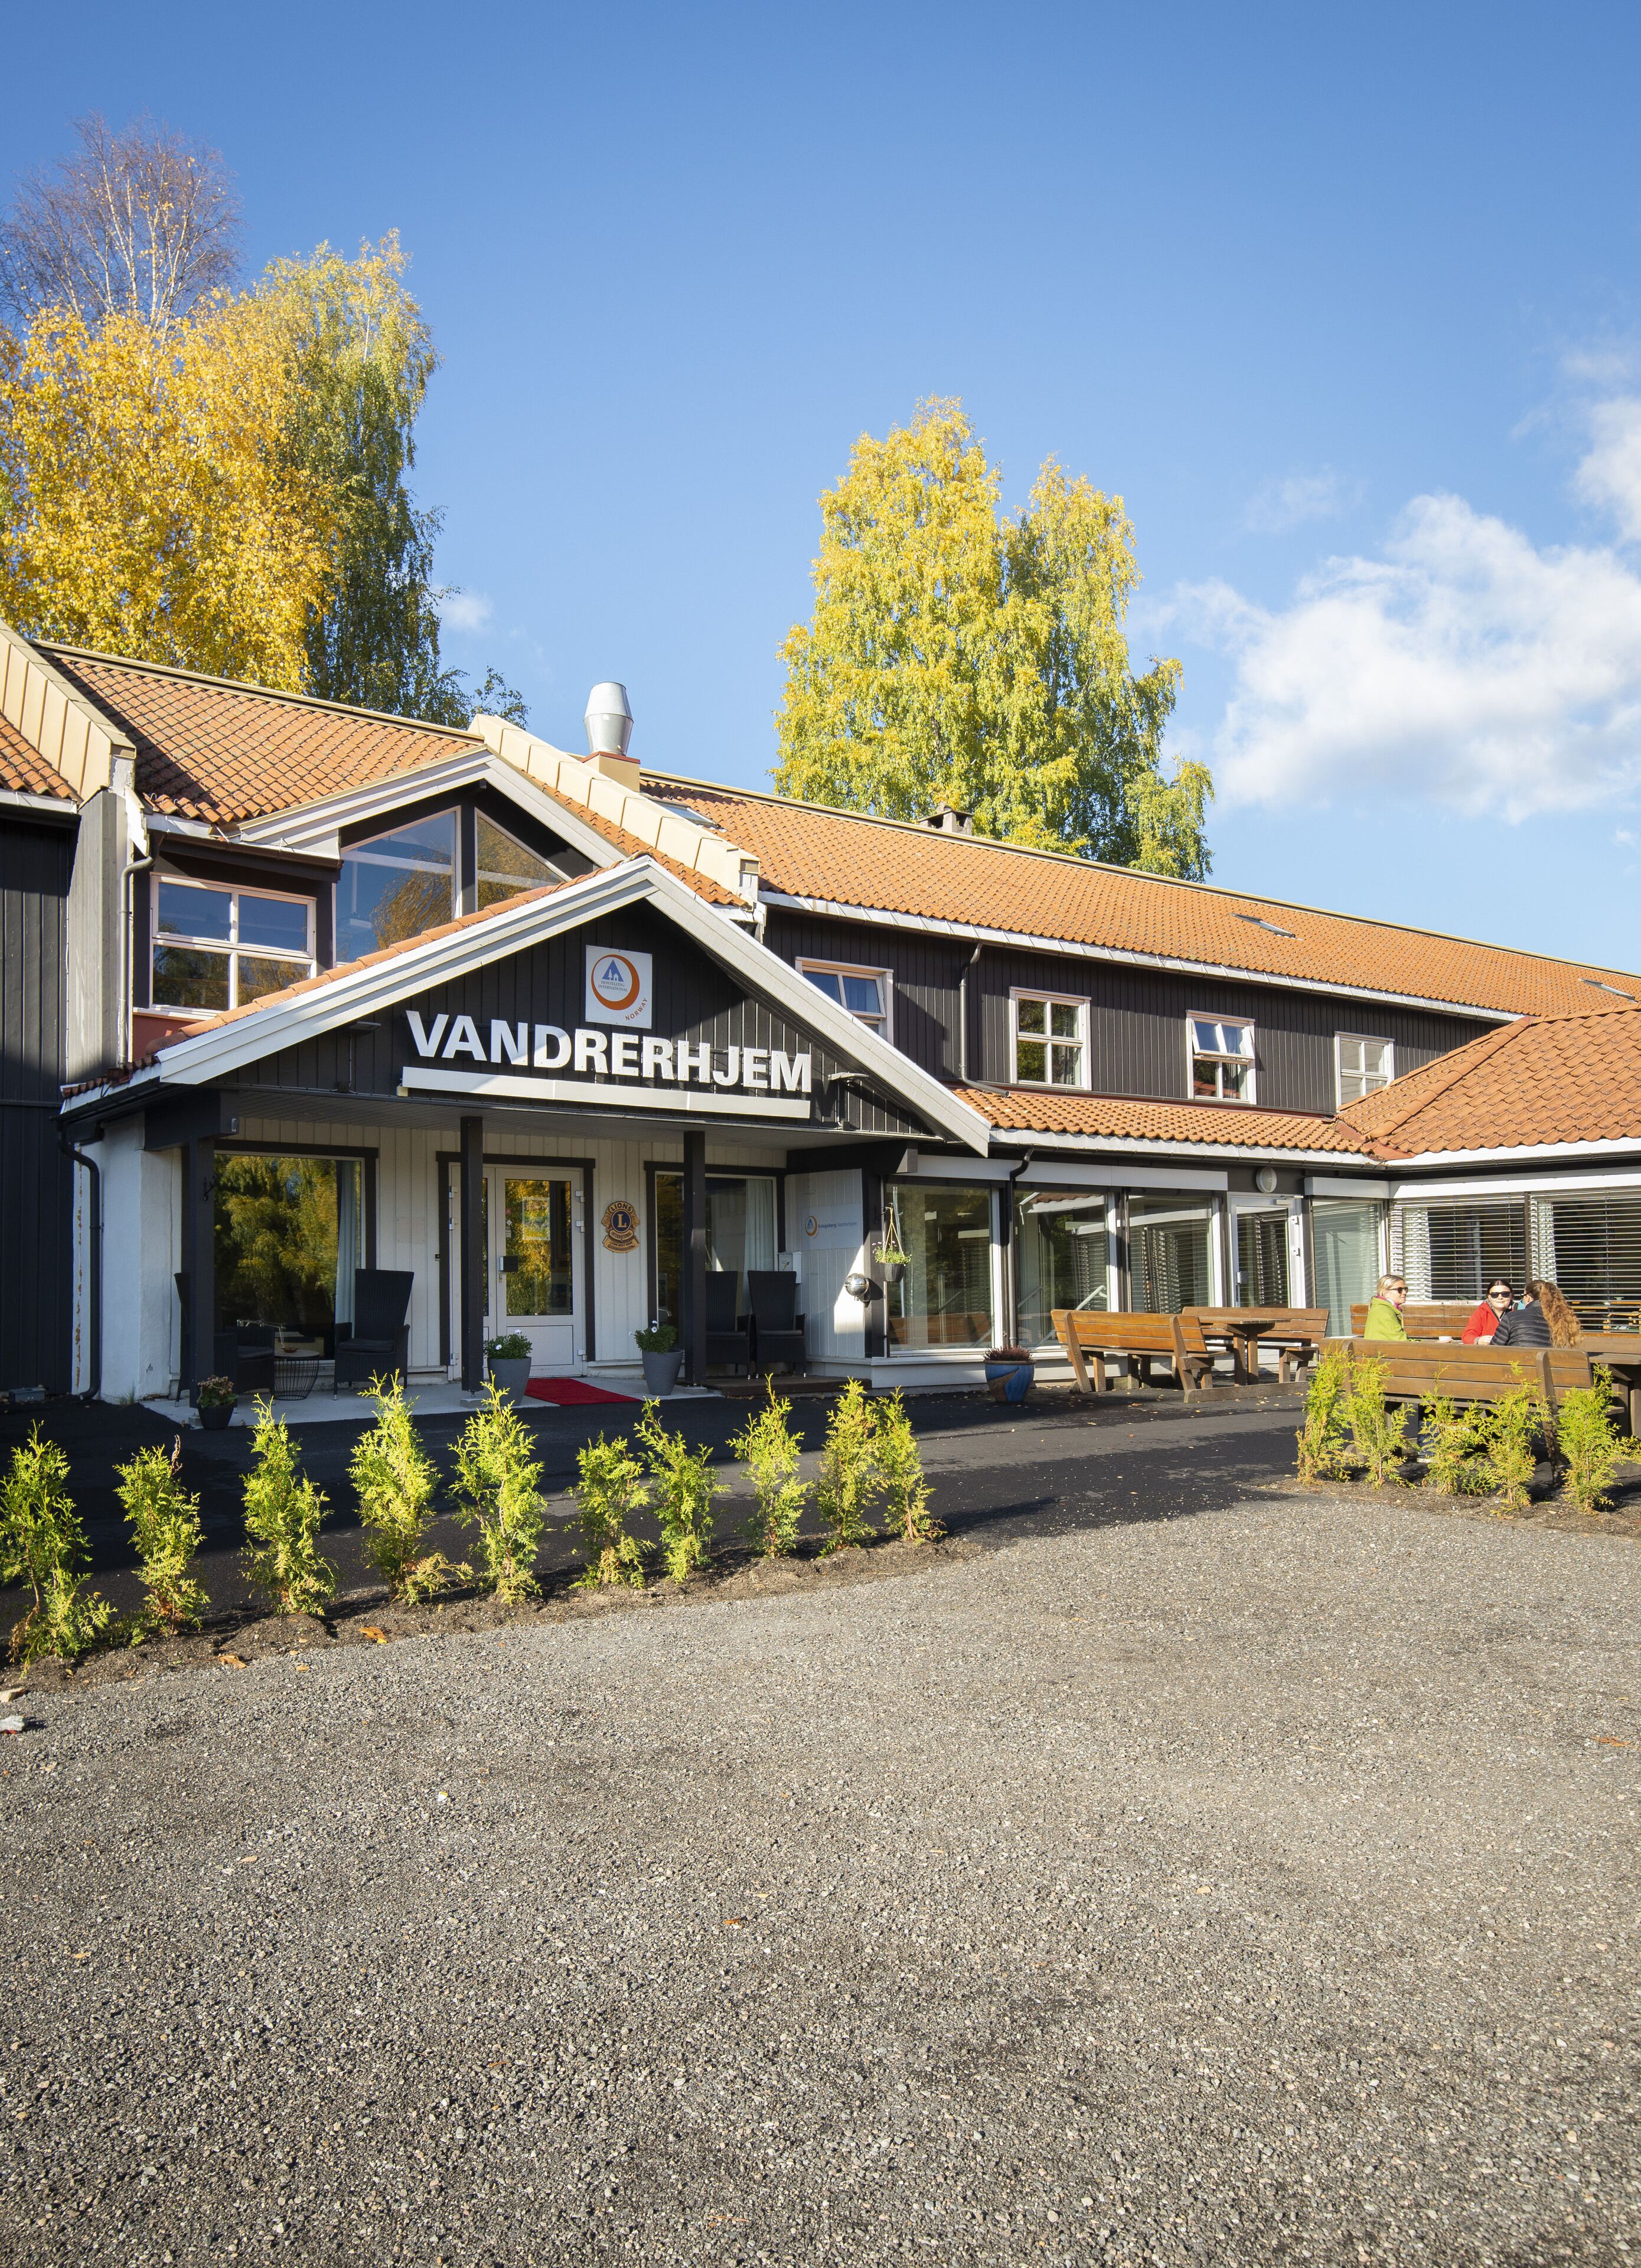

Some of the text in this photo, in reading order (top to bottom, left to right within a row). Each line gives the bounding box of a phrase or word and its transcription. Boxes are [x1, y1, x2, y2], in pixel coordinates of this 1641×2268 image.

[598, 984, 628, 992] INTERNATIONAL
[625, 998, 648, 1021] NORWAY
[406, 1010, 811, 1093] VANDRERHJEM
[611, 1203, 632, 1212] LIONS
[617, 1214, 627, 1228] L
